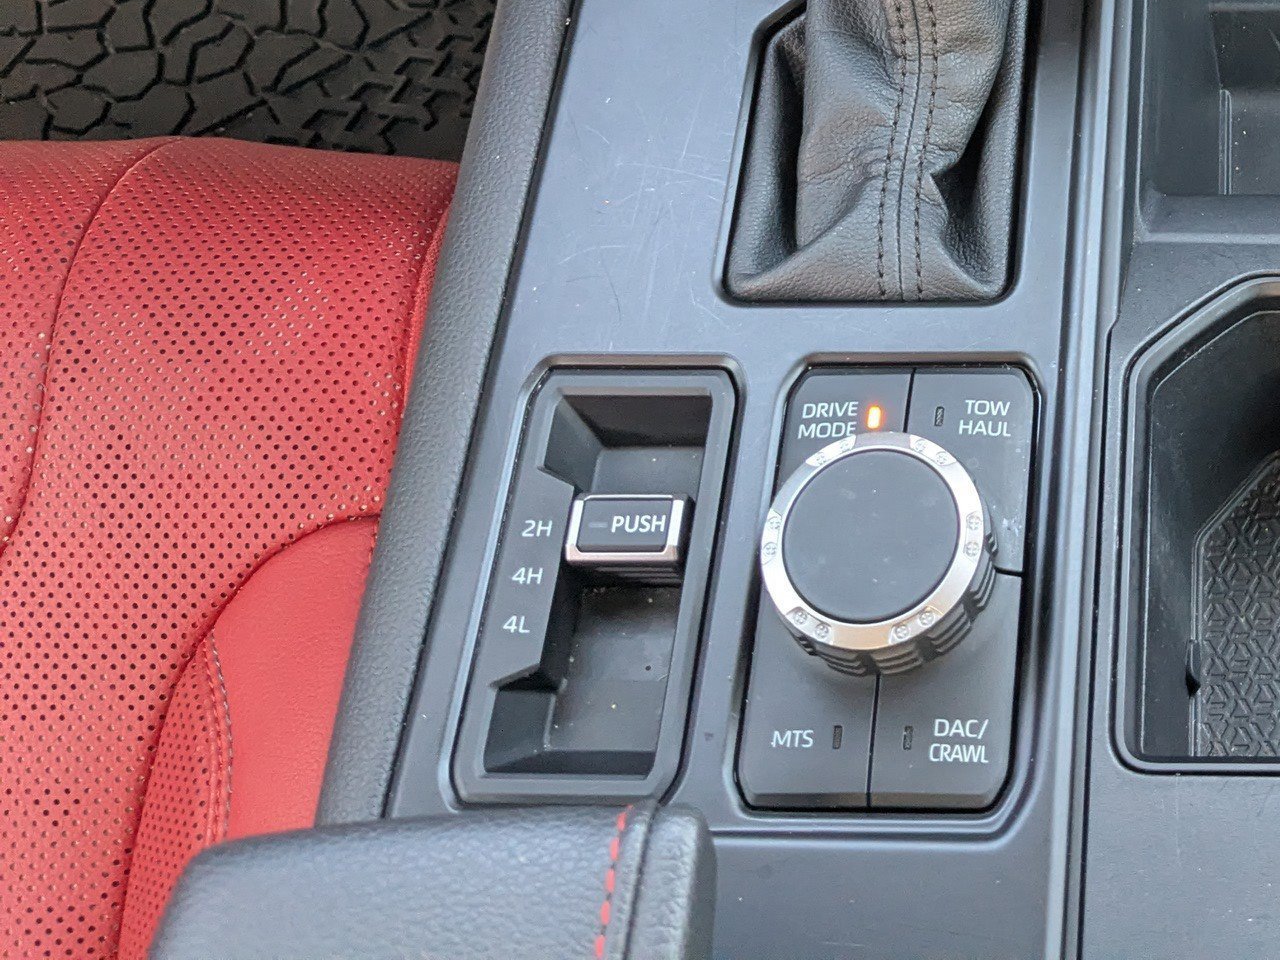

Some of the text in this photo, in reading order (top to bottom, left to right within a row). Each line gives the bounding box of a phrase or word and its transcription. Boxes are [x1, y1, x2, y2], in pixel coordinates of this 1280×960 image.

[802, 401, 859, 419] DRIVE
[965, 399, 1011, 417] TOW
[797, 422, 857, 439] MODE
[959, 419, 1012, 437] HAUL
[522, 520, 553, 538] 2H
[611, 515, 666, 533] PUSH
[512, 567, 544, 585] 4H
[503, 616, 530, 634] 4L
[934, 719, 989, 739] DAC/
[772, 730, 814, 748] MTS
[929, 744, 989, 764] CRAWL
